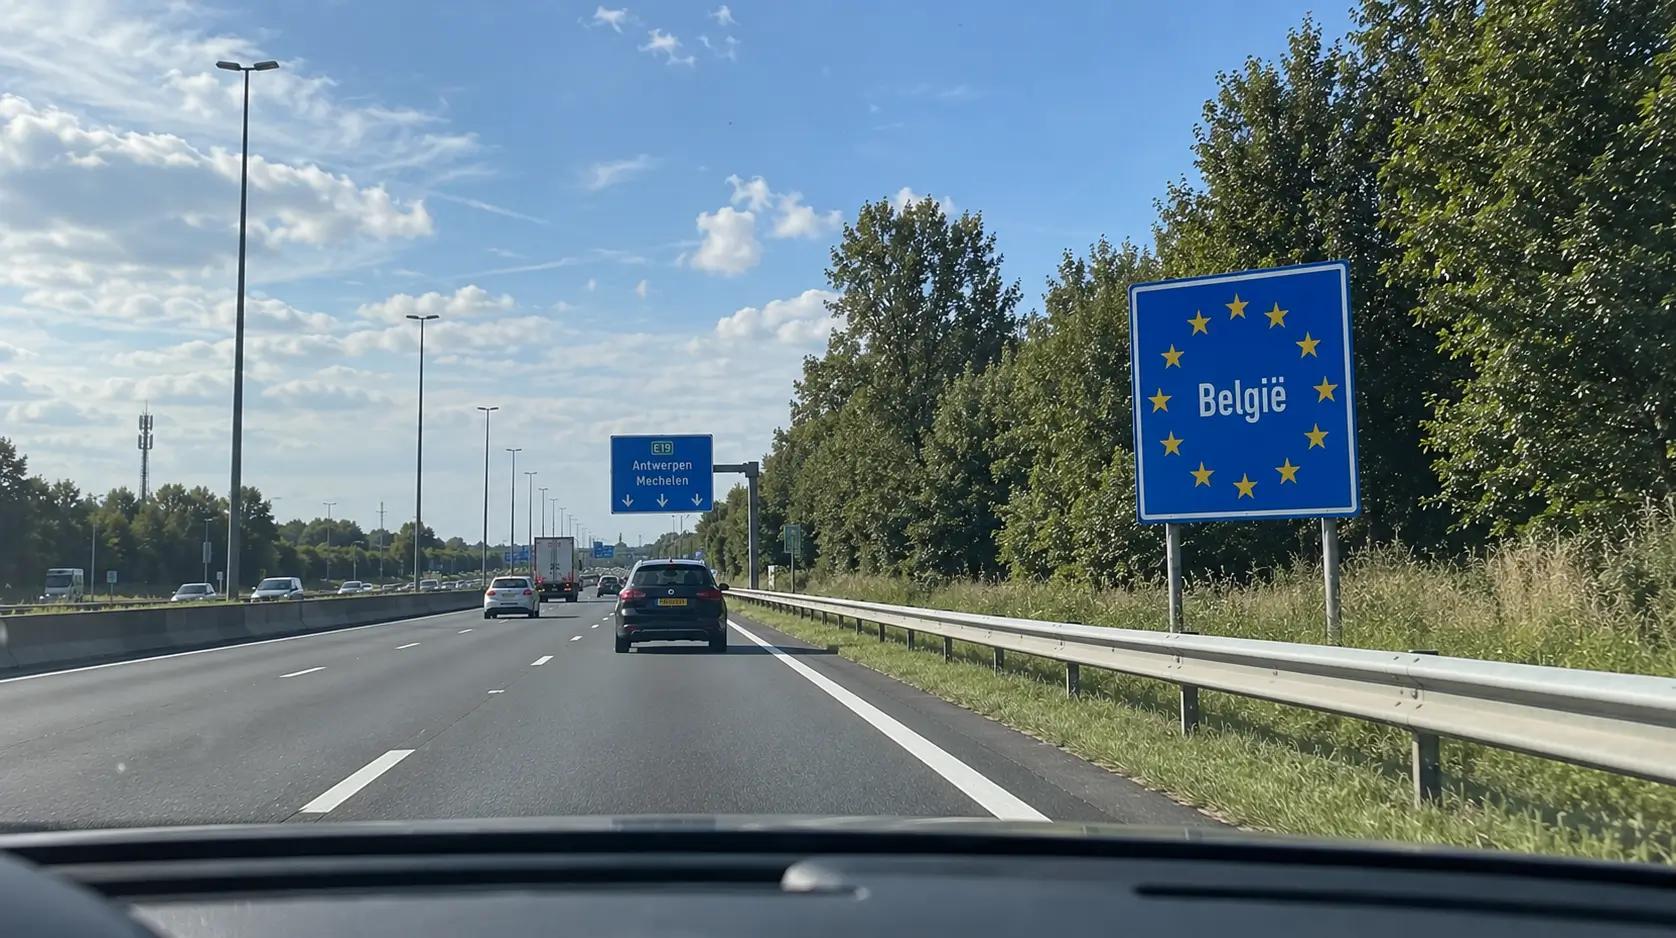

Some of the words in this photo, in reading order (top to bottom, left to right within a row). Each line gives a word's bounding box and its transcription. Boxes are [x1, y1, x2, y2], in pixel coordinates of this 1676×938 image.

[1198, 376, 1287, 424] België
[653, 443, 671, 453] E19
[632, 460, 693, 472] Antwerpen
[636, 475, 689, 486] Mechelen
